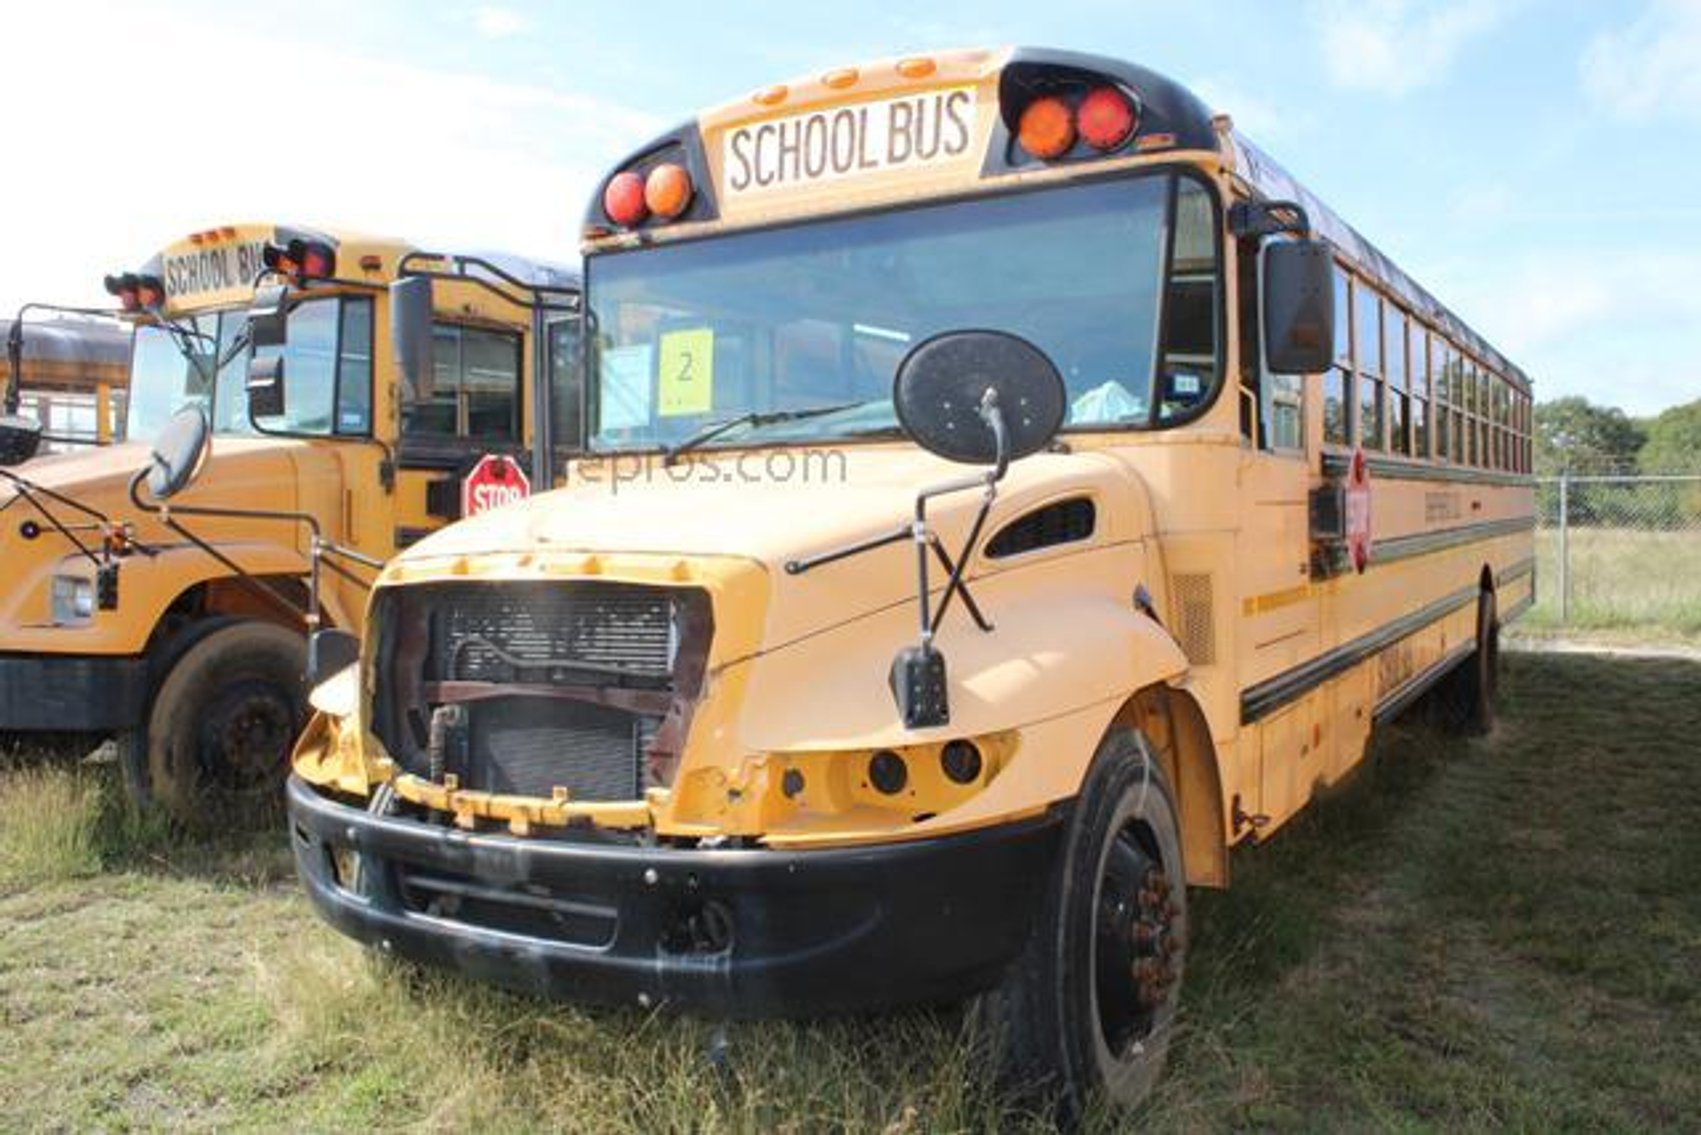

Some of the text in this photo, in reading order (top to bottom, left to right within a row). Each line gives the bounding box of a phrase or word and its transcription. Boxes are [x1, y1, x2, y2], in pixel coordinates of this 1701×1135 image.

[731, 90, 969, 190] SCHOOL BUS
[166, 247, 232, 295] SCHOOL
[677, 352, 693, 381] 2
